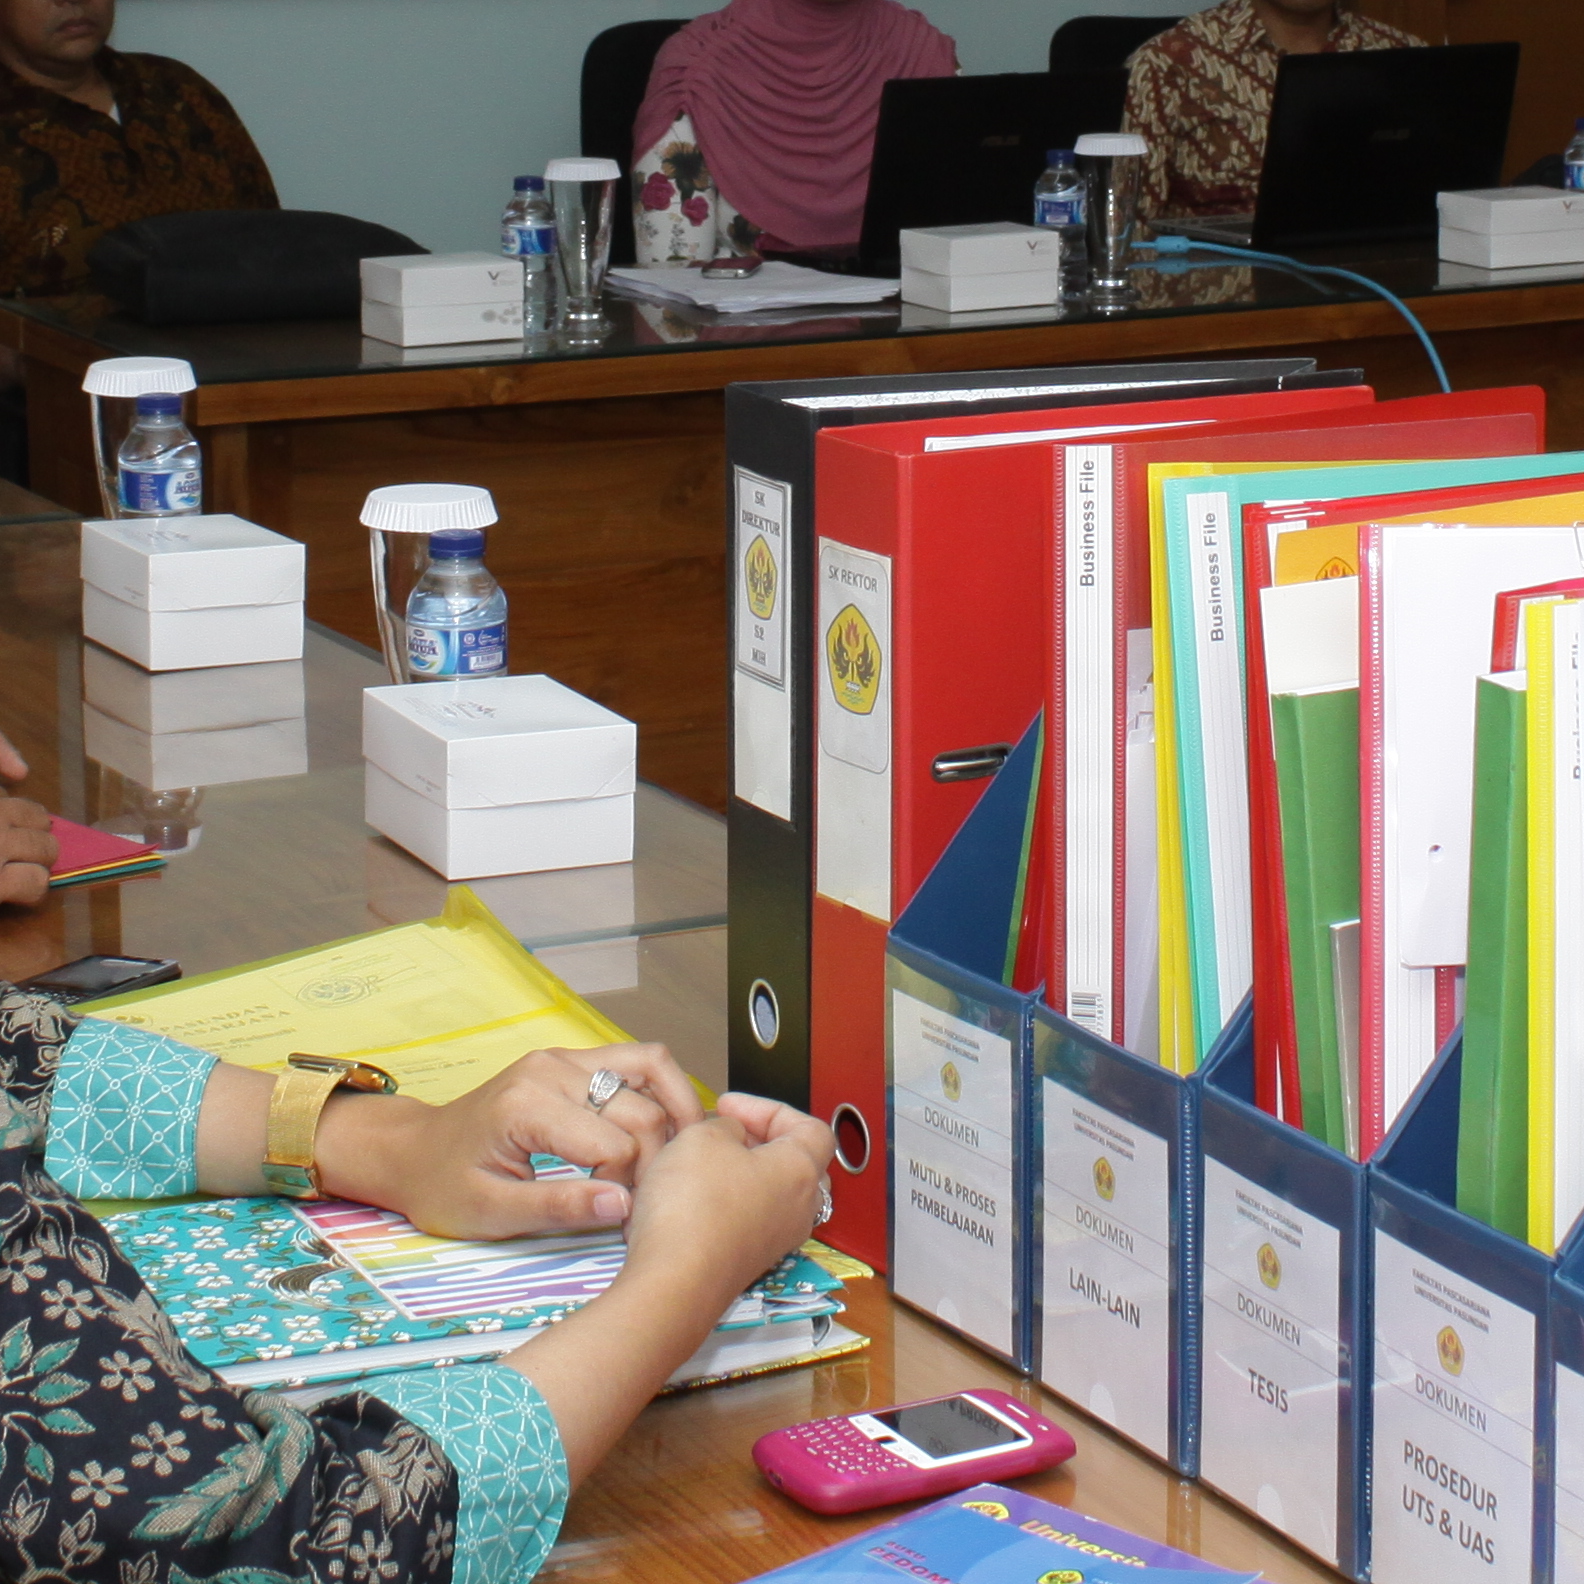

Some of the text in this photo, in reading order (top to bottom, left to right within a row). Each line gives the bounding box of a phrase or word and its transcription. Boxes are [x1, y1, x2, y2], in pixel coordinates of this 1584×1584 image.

[742, 510, 780, 537] DIREKTUR
[754, 491, 765, 507] SK
[1080, 460, 1094, 587] Business File
[828, 565, 878, 593] SK REKTOR
[1204, 513, 1224, 641] Business File
[924, 1106, 979, 1147] DOKUMEN
[909, 1159, 996, 1217] MUTU & PROSES
[911, 1189, 994, 1247] PEMBELAJARAN
[1076, 1205, 1133, 1254] DOKUMEN
[1069, 1267, 1140, 1329] LAIN-LAIN
[1237, 1292, 1300, 1346] DOKUMEN
[1248, 1367, 1288, 1413] TESIS
[1416, 1373, 1486, 1432] DOKUMEN
[1404, 1439, 1497, 1521] PROSEDUR
[1403, 1484, 1494, 1564] UTS & UAS
